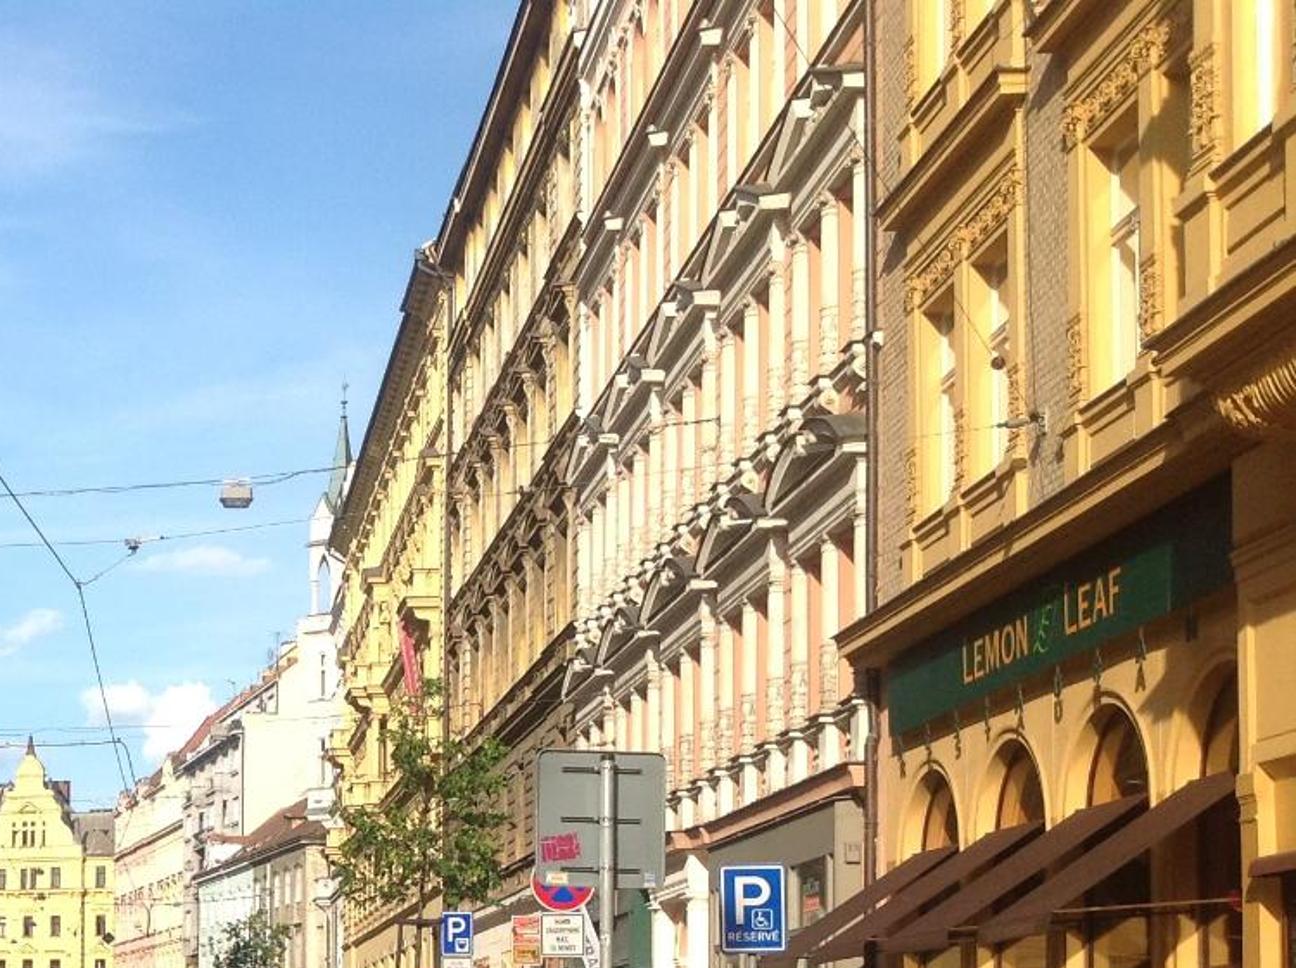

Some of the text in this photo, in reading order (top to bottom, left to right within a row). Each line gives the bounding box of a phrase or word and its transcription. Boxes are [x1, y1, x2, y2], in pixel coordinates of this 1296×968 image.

[961, 614, 1030, 685] LEMON
[1062, 565, 1123, 636] LEAF
[733, 875, 772, 926] P
[447, 917, 466, 943] P
